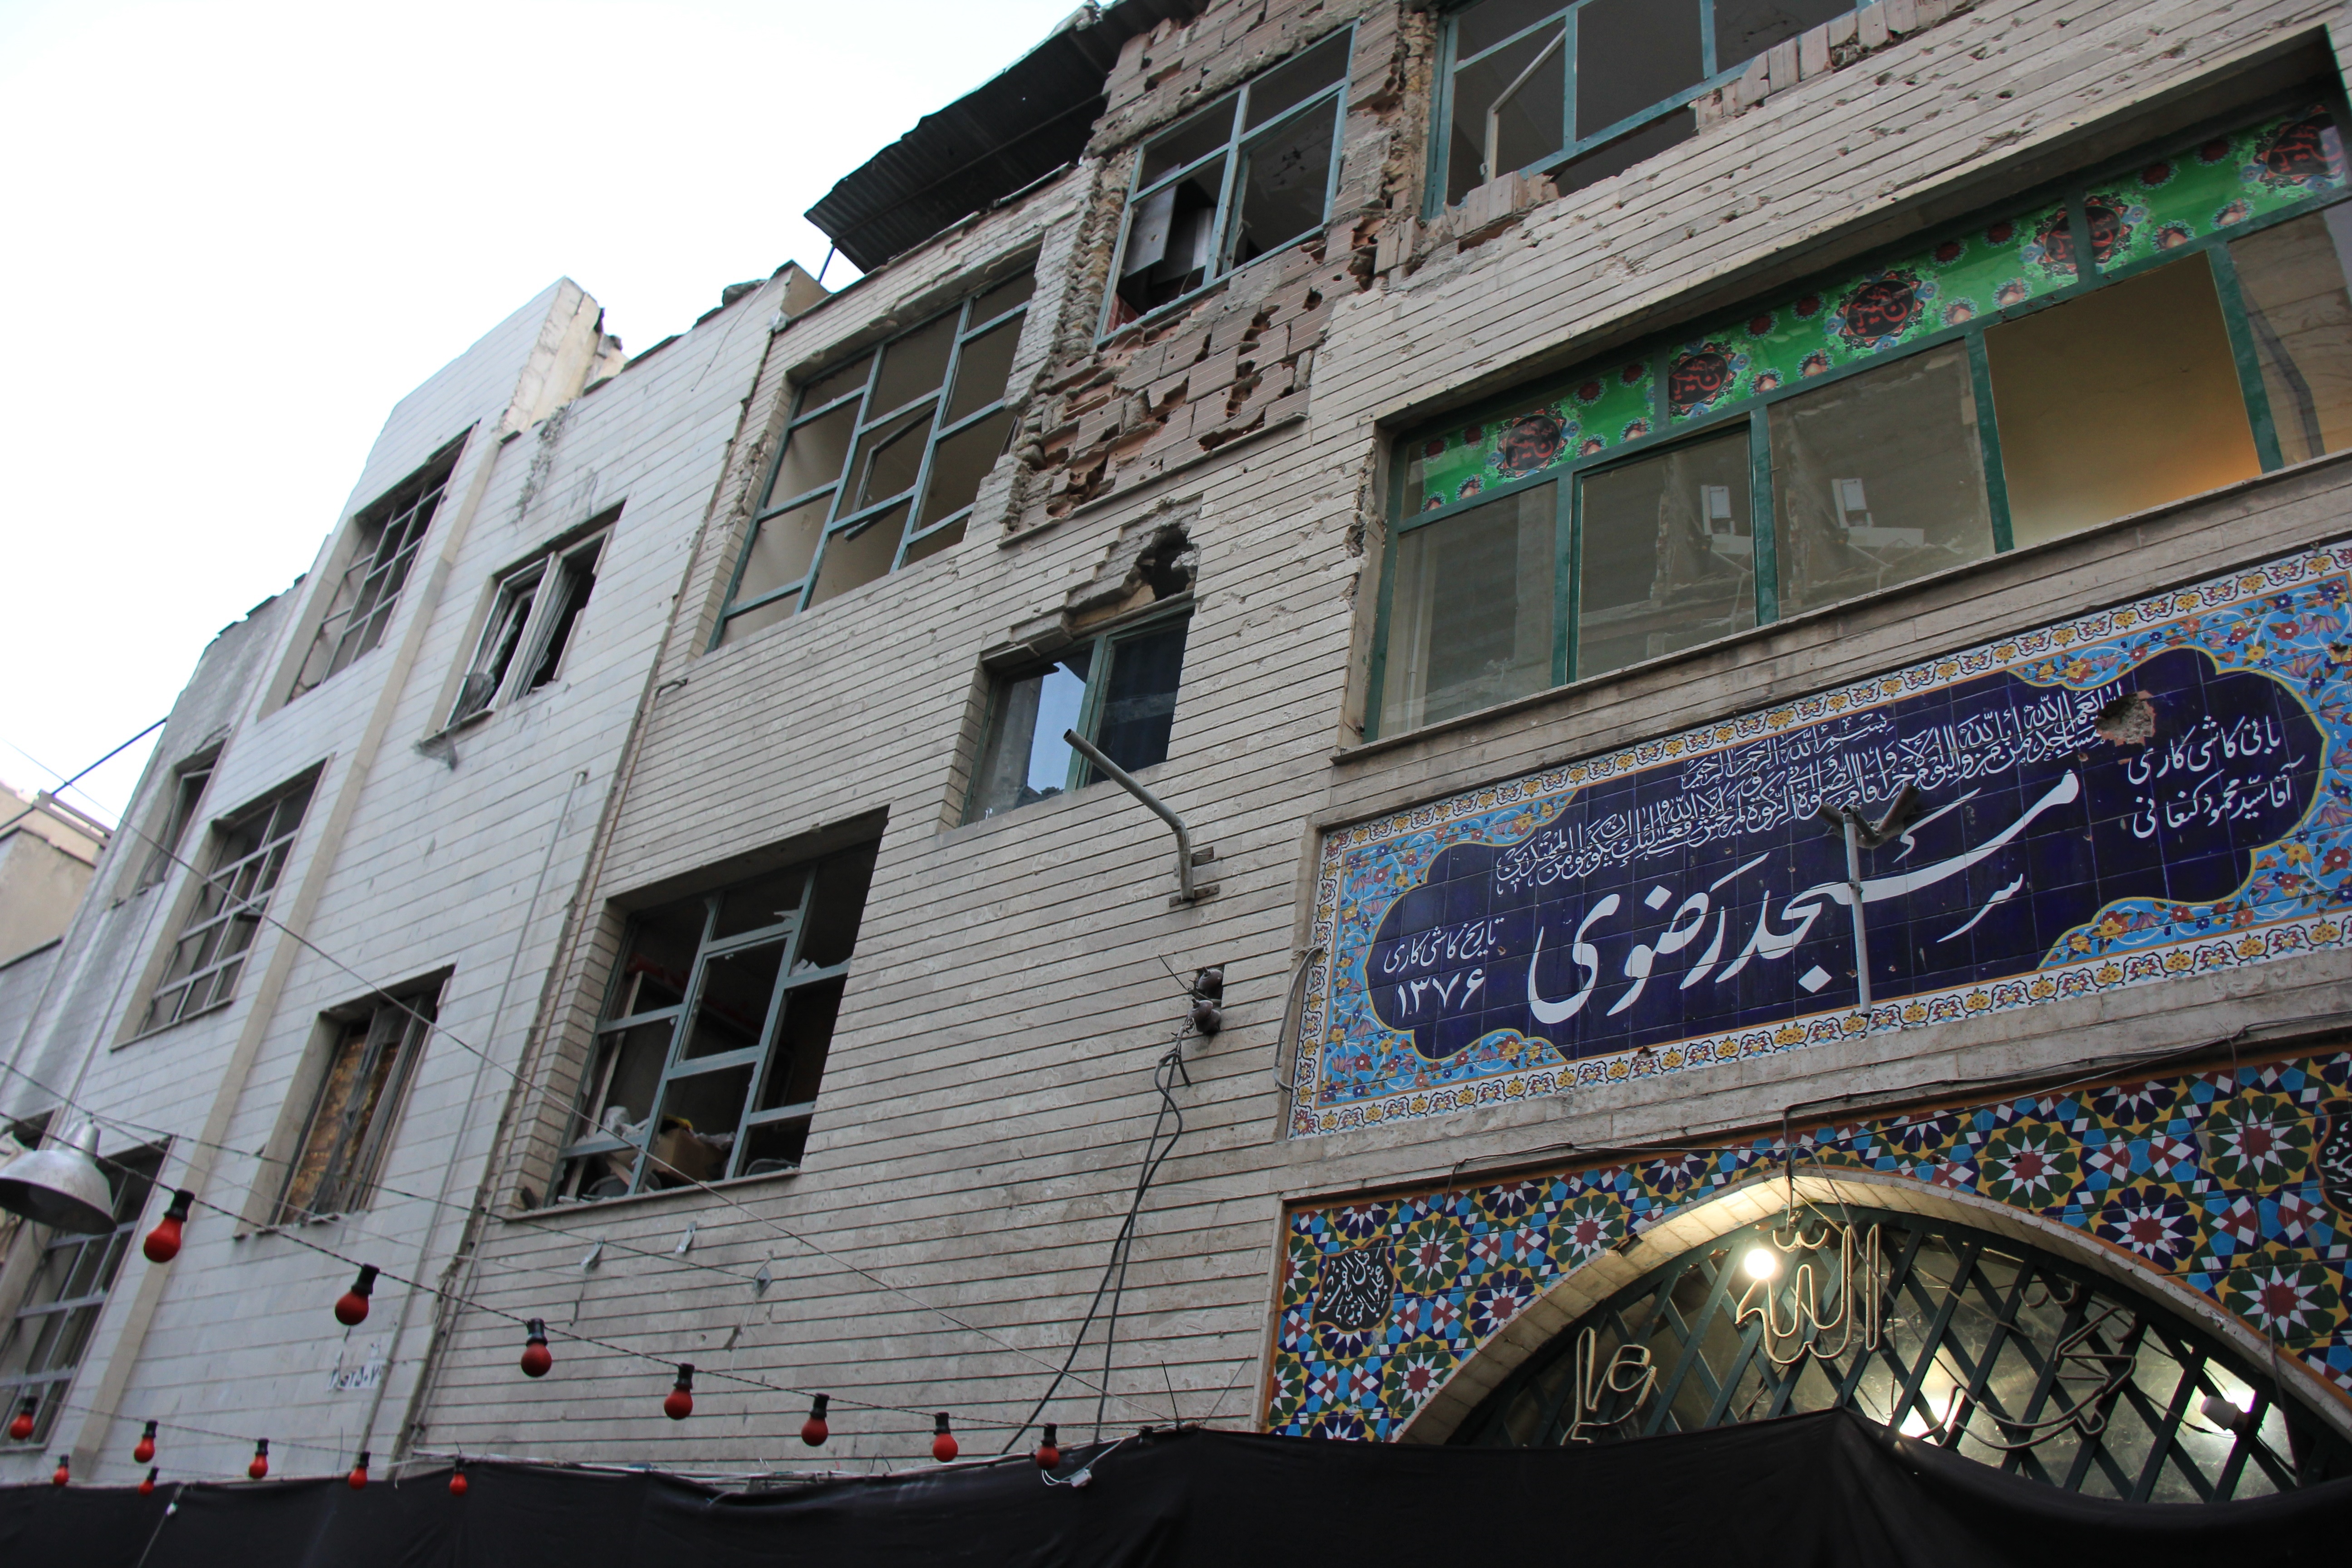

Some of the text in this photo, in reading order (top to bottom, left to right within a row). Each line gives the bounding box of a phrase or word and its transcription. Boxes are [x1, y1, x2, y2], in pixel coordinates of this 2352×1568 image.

[1780, 725, 1819, 764] الله
[2128, 715, 2280, 785] بانی کاشی کاری
[2132, 769, 2225, 838] کنعانی
[2203, 779, 2240, 826] محمود
[2269, 755, 2305, 808] آقا
[1529, 769, 2080, 1024] مسجد رضوی
[1384, 917, 1504, 974] تاریخ کاشی کاری
[1397, 968, 1485, 1018] ۱۳۷۶
[1735, 1222, 1881, 1365] الله
